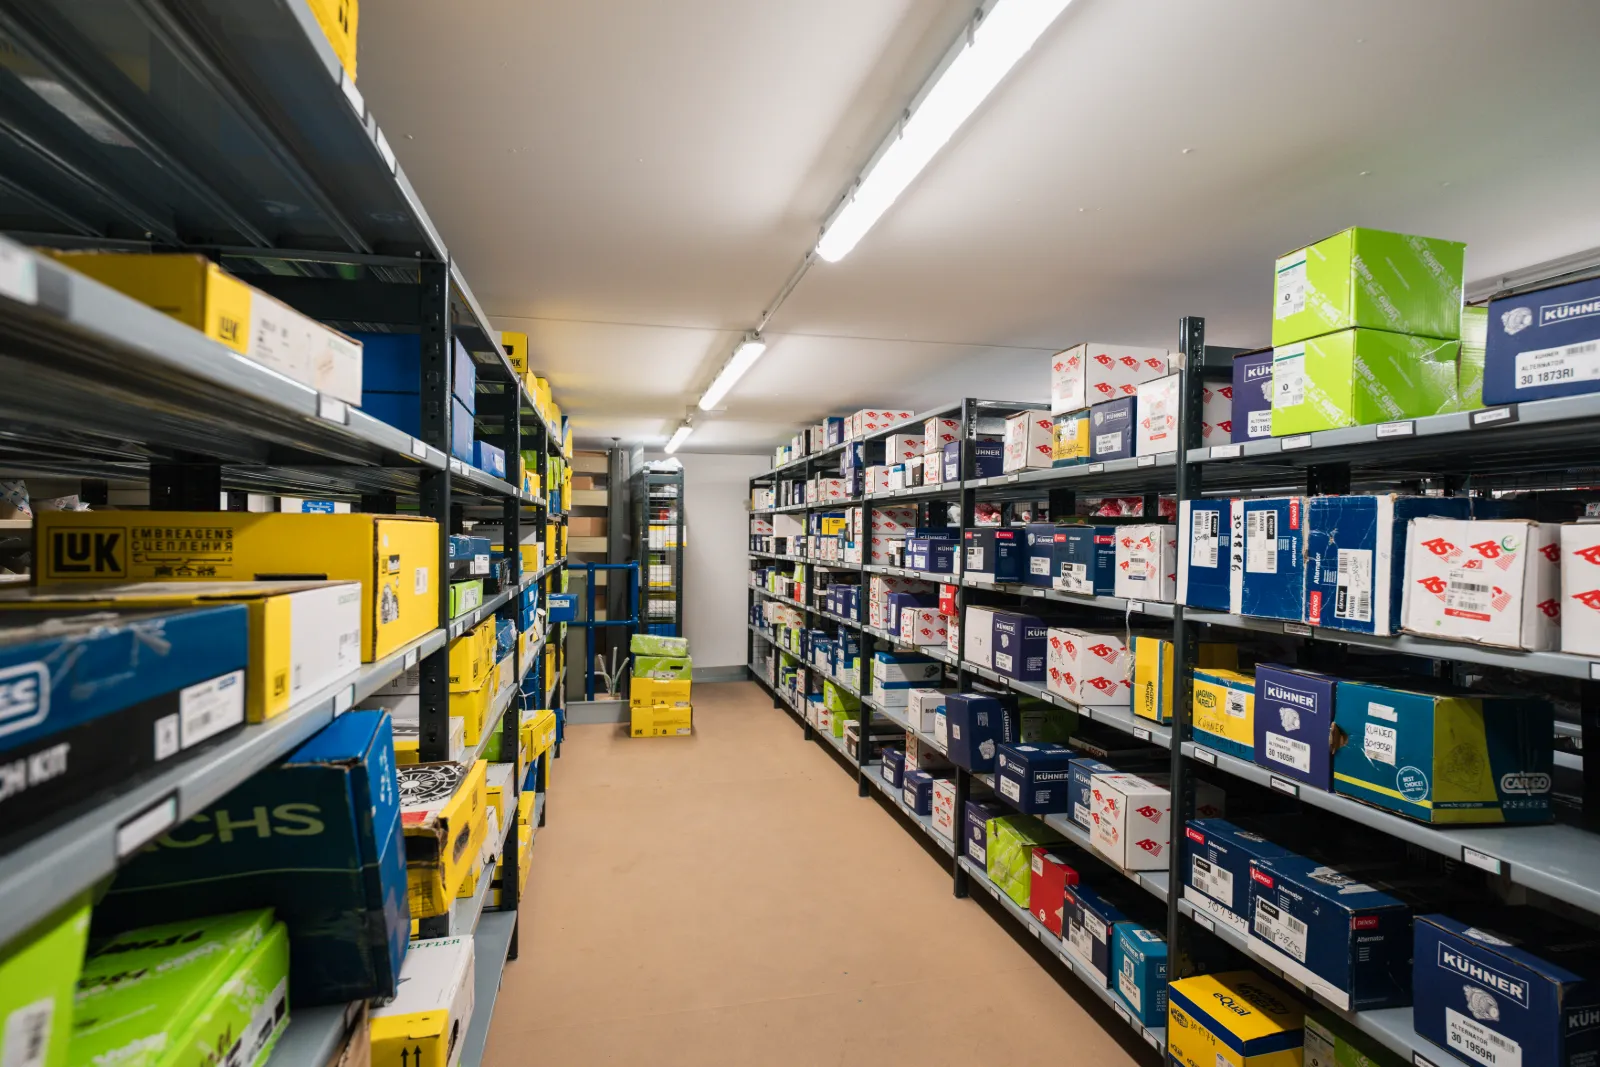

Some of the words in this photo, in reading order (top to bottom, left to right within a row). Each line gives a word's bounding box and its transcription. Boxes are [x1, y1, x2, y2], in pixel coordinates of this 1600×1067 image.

[1353, 254, 1373, 281] Valeo
[1354, 356, 1375, 381] Valeo
[1521, 359, 1565, 371] ALTERNATOR
[1521, 375, 1533, 385] 30
[1538, 368, 1574, 382] 1873RI
[131, 528, 234, 540] EMBREAGENS
[53, 533, 122, 572] LUK
[131, 541, 234, 552] СЦЕПЛЕНИЯ
[1313, 552, 1322, 585] Alternator
[1267, 686, 1314, 707] KÜHNER
[1003, 709, 1011, 743] KÜHNER
[1268, 748, 1276, 756] 30
[1277, 751, 1295, 764] 1905RI
[1007, 762, 1025, 774] KÜHNER
[1035, 772, 1069, 781] KÜHNER
[1402, 775, 1415, 783] BEST
[1404, 781, 1424, 789] CHOICE!
[1189, 831, 1203, 841] DENSO
[1208, 840, 1228, 854] Alternator
[1254, 872, 1271, 884] DENSO
[1278, 885, 1303, 901] Alternator
[1356, 918, 1376, 926] DENSO
[407, 938, 461, 950] EFFLER
[1357, 935, 1384, 943] Alternator
[1443, 951, 1523, 1000] KÜHNER
[1213, 991, 1252, 1017] eQual
[1451, 1022, 1489, 1046] ALTERNATOR
[1451, 1031, 1462, 1045] 30
[1465, 1039, 1496, 1064] 1959RI
